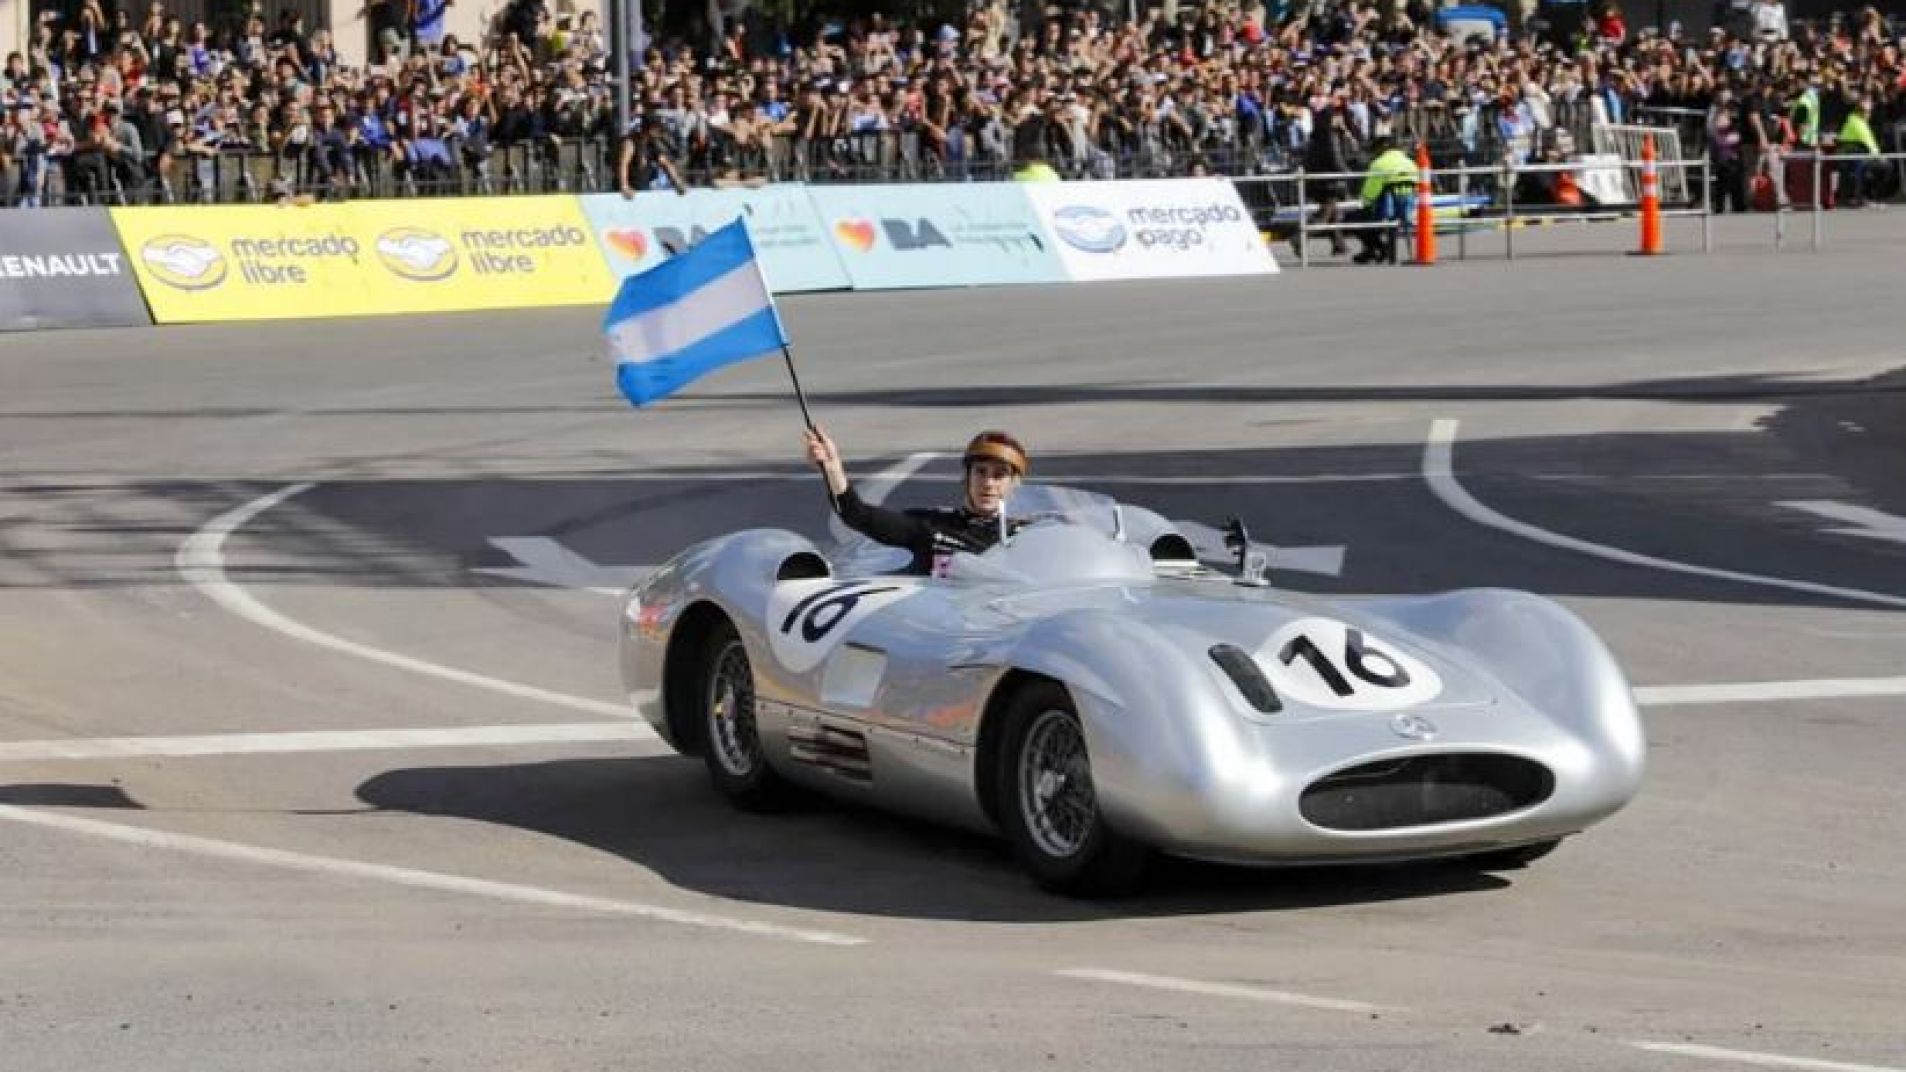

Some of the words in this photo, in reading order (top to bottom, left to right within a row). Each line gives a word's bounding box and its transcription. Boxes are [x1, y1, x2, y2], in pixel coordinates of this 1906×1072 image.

[1127, 204, 1241, 224] mercado
[231, 232, 359, 258] mercado
[461, 224, 585, 249] mercado
[881, 217, 953, 251] BA
[1136, 228, 1202, 251] pago
[239, 258, 307, 284] libre
[470, 250, 535, 274] libre
[780, 580, 900, 643] 16
[1278, 627, 1411, 697] 16
